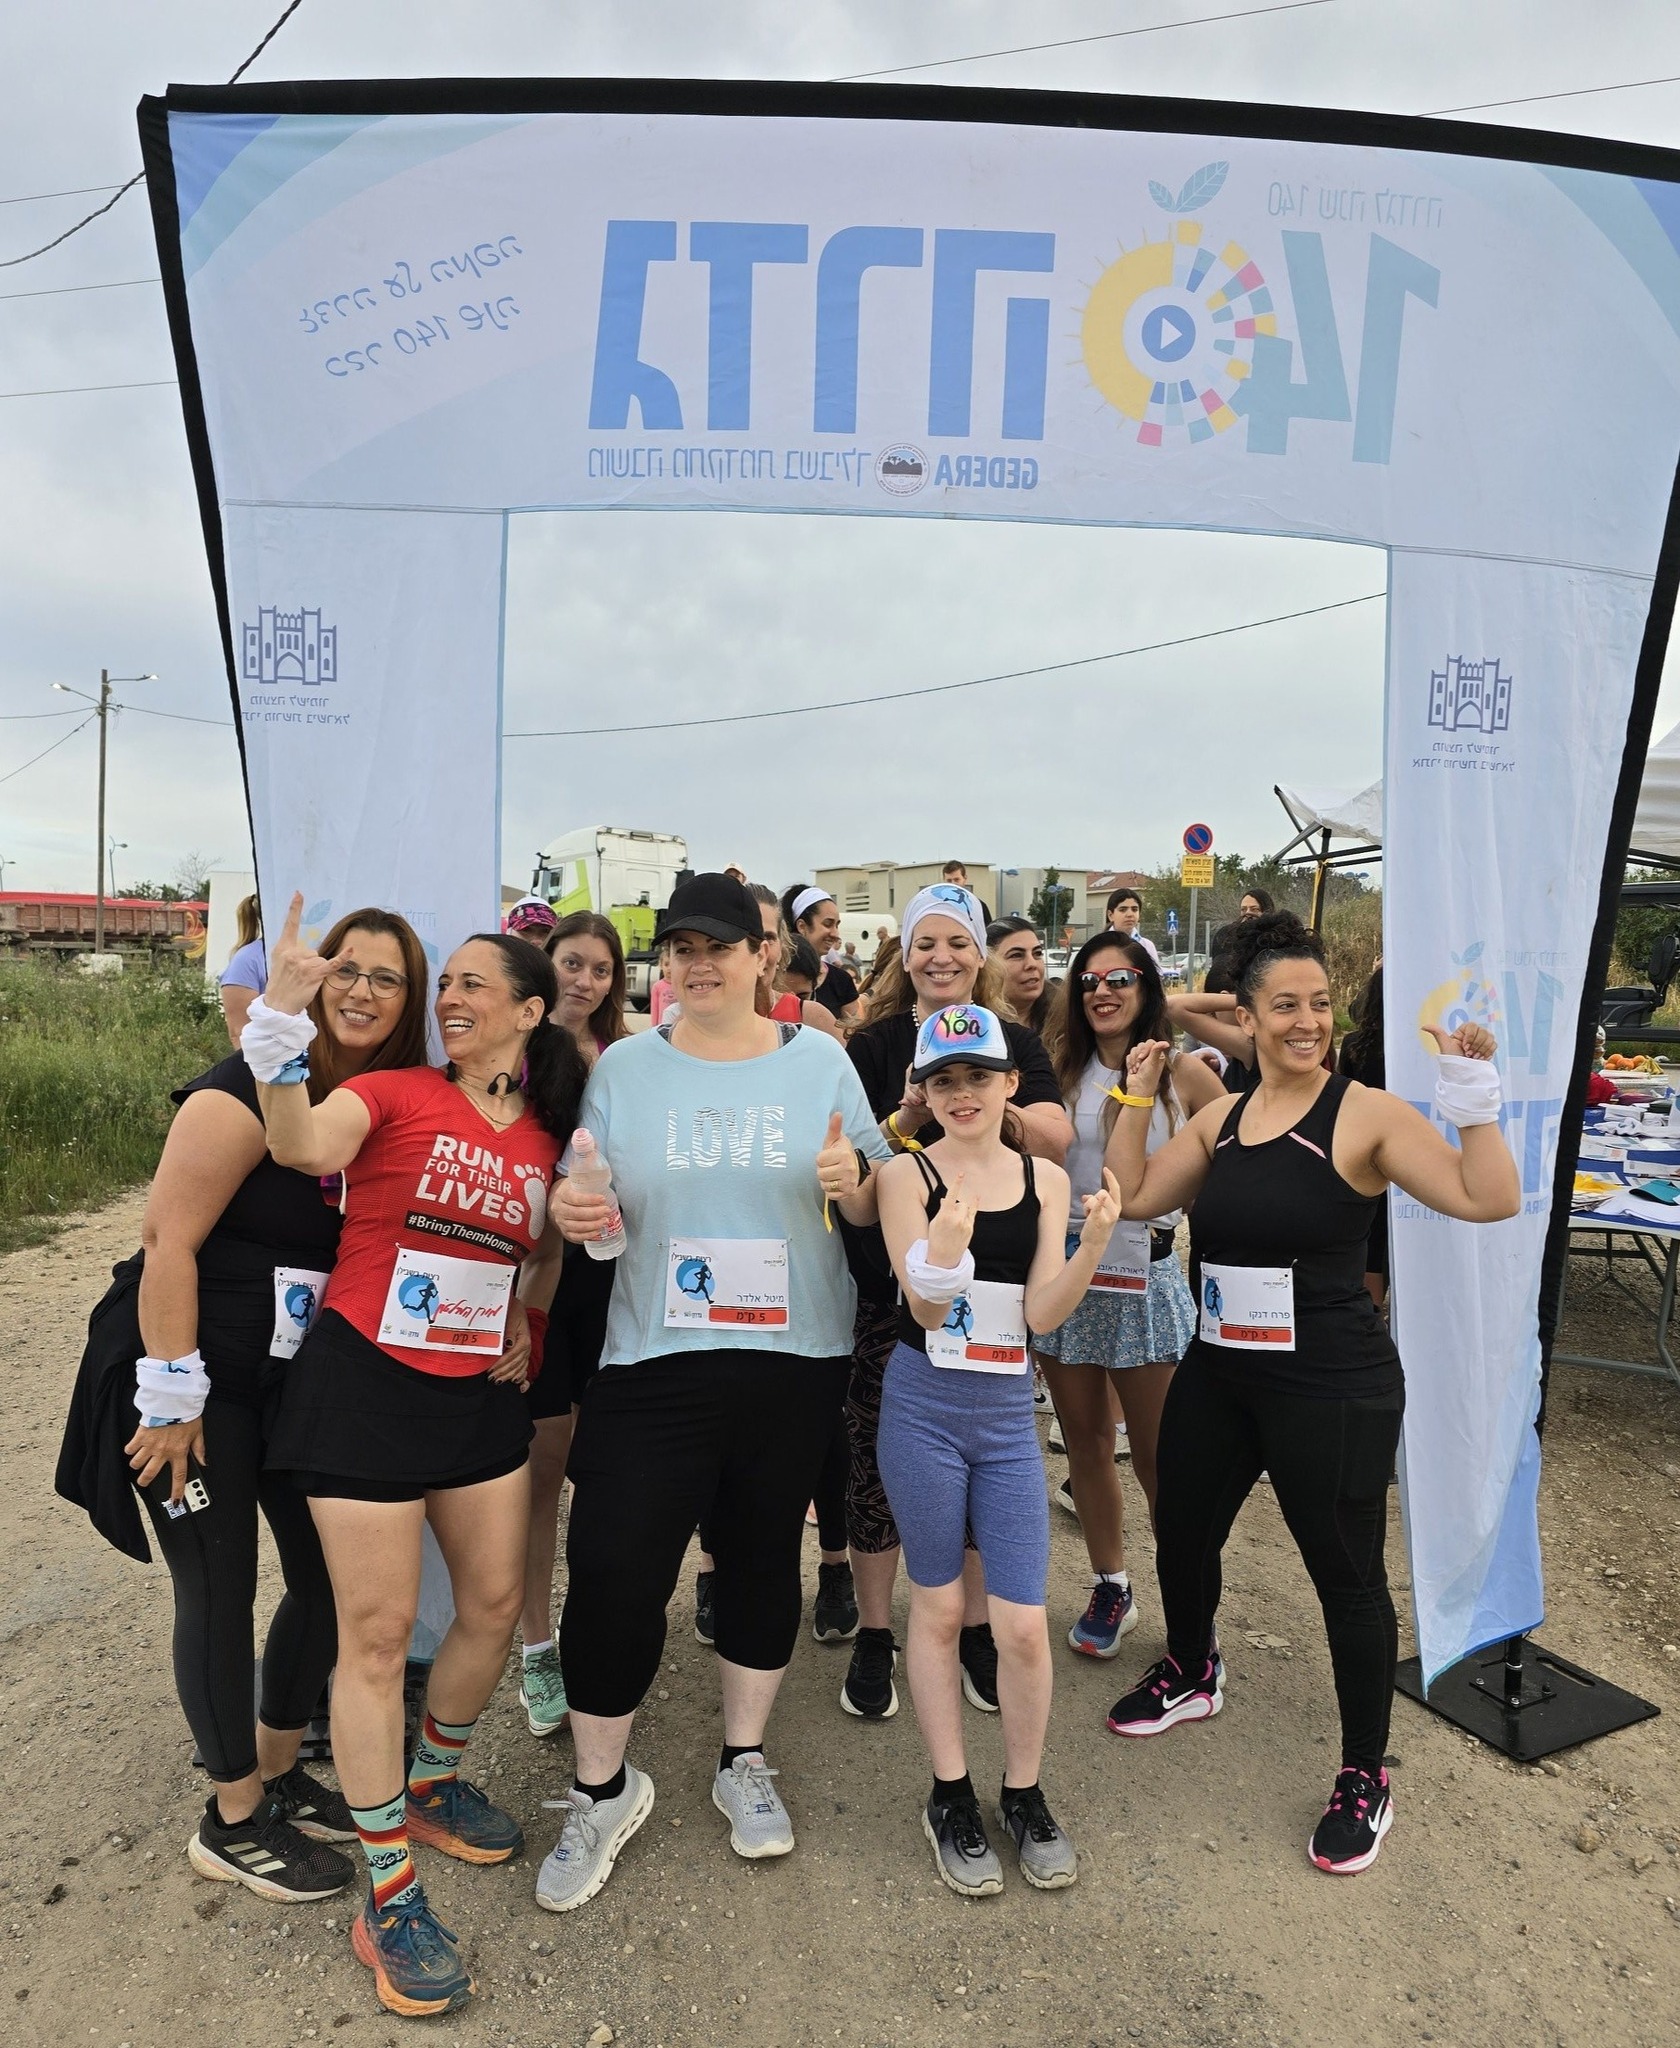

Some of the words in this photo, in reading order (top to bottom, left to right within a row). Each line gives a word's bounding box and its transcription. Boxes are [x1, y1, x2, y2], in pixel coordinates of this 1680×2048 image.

[666, 1106, 787, 1170] LOVE
[431, 1134, 504, 1178] RUN
[424, 1158, 460, 1177] FOR
[467, 1168, 512, 1195] THEIR
[415, 1173, 525, 1225] LIVES
[1120, 1266, 1145, 1275] ליאורה
[737, 1293, 761, 1303] אלדר
[764, 1293, 784, 1303] מיטל
[760, 1313, 765, 1321] 5
[1249, 1311, 1268, 1320] דנקו
[1271, 1311, 1290, 1319] פרח
[472, 1334, 478, 1343] 5
[1262, 1331, 1268, 1339] 5
[1009, 1351, 1014, 1360] 5
